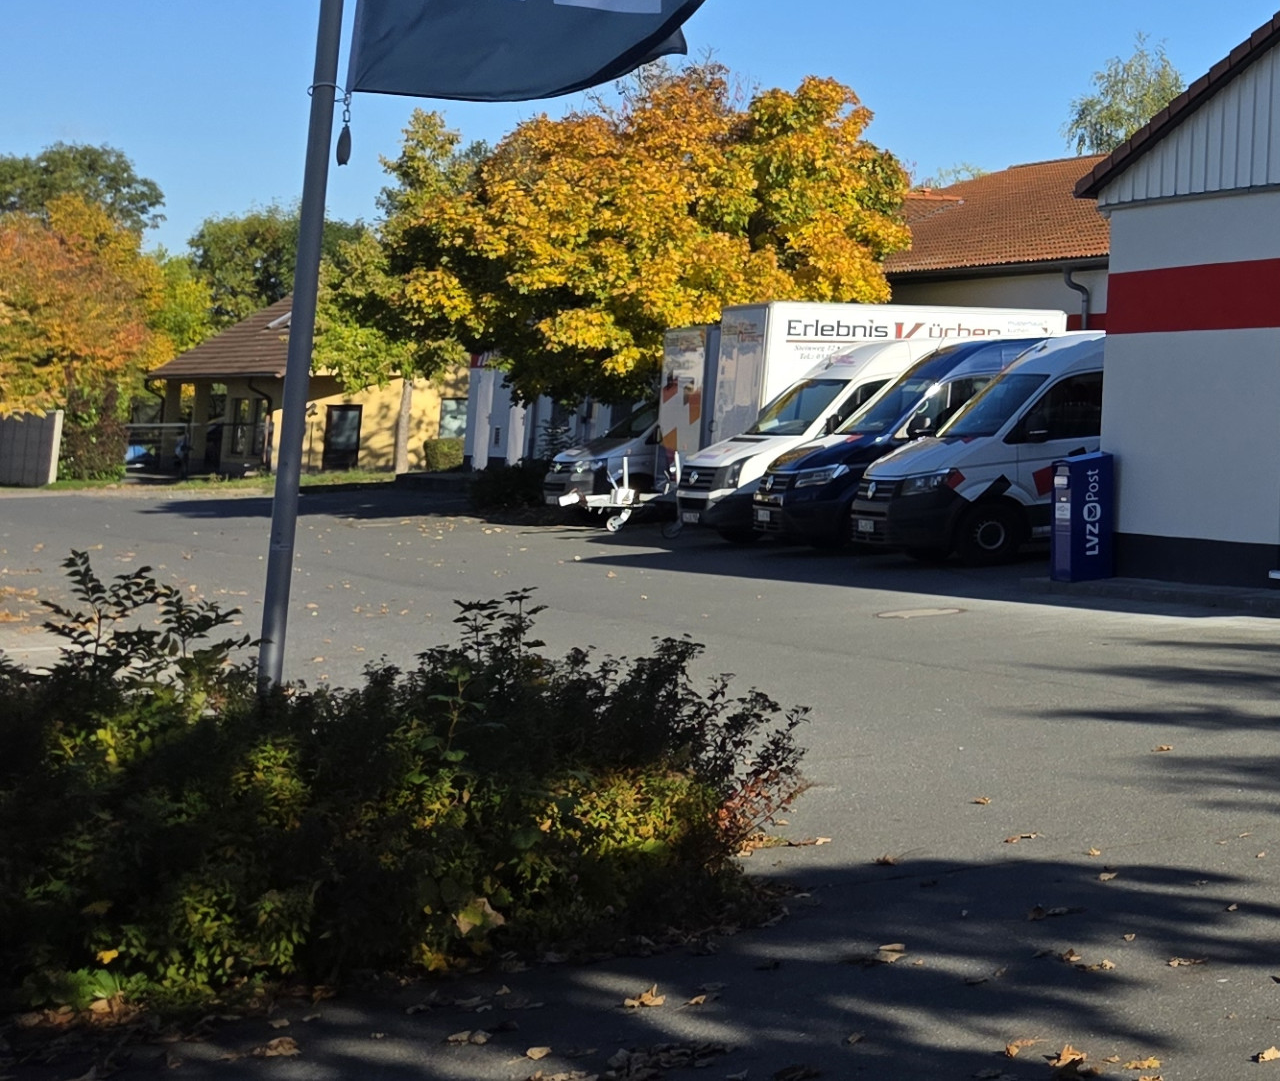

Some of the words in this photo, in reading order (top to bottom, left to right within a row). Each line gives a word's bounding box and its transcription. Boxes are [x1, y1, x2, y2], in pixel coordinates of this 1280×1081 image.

[787, 319, 889, 338] Erlebnis
[1085, 468, 1099, 501] Post
[1085, 522, 1099, 556] LVZ
